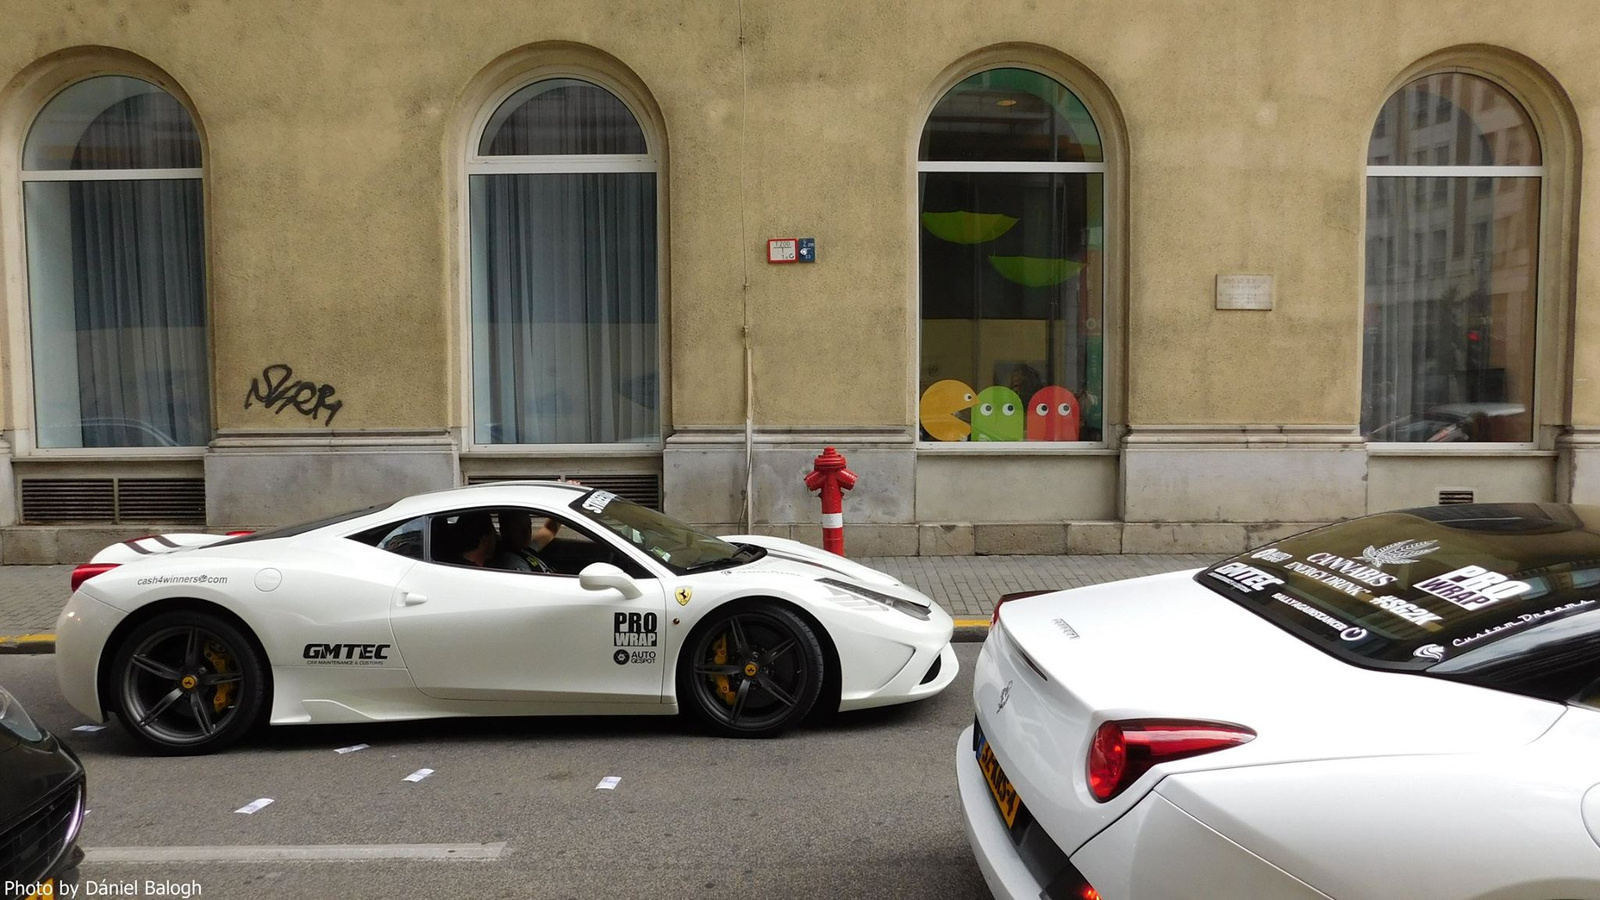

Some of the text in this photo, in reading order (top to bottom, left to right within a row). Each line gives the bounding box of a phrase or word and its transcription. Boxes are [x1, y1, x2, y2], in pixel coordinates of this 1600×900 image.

[1284, 562, 1364, 596] ENERGY DRINK
[1306, 552, 1398, 587] CANNABIS
[1441, 565, 1531, 600] PRO
[1420, 578, 1491, 606] WRAP
[614, 612, 657, 633] PRO
[1369, 595, 1443, 626] #SG2K
[1453, 599, 1596, 646] Custom Dreams
[302, 643, 390, 659] GMTEC
[615, 633, 656, 646] WRAP
